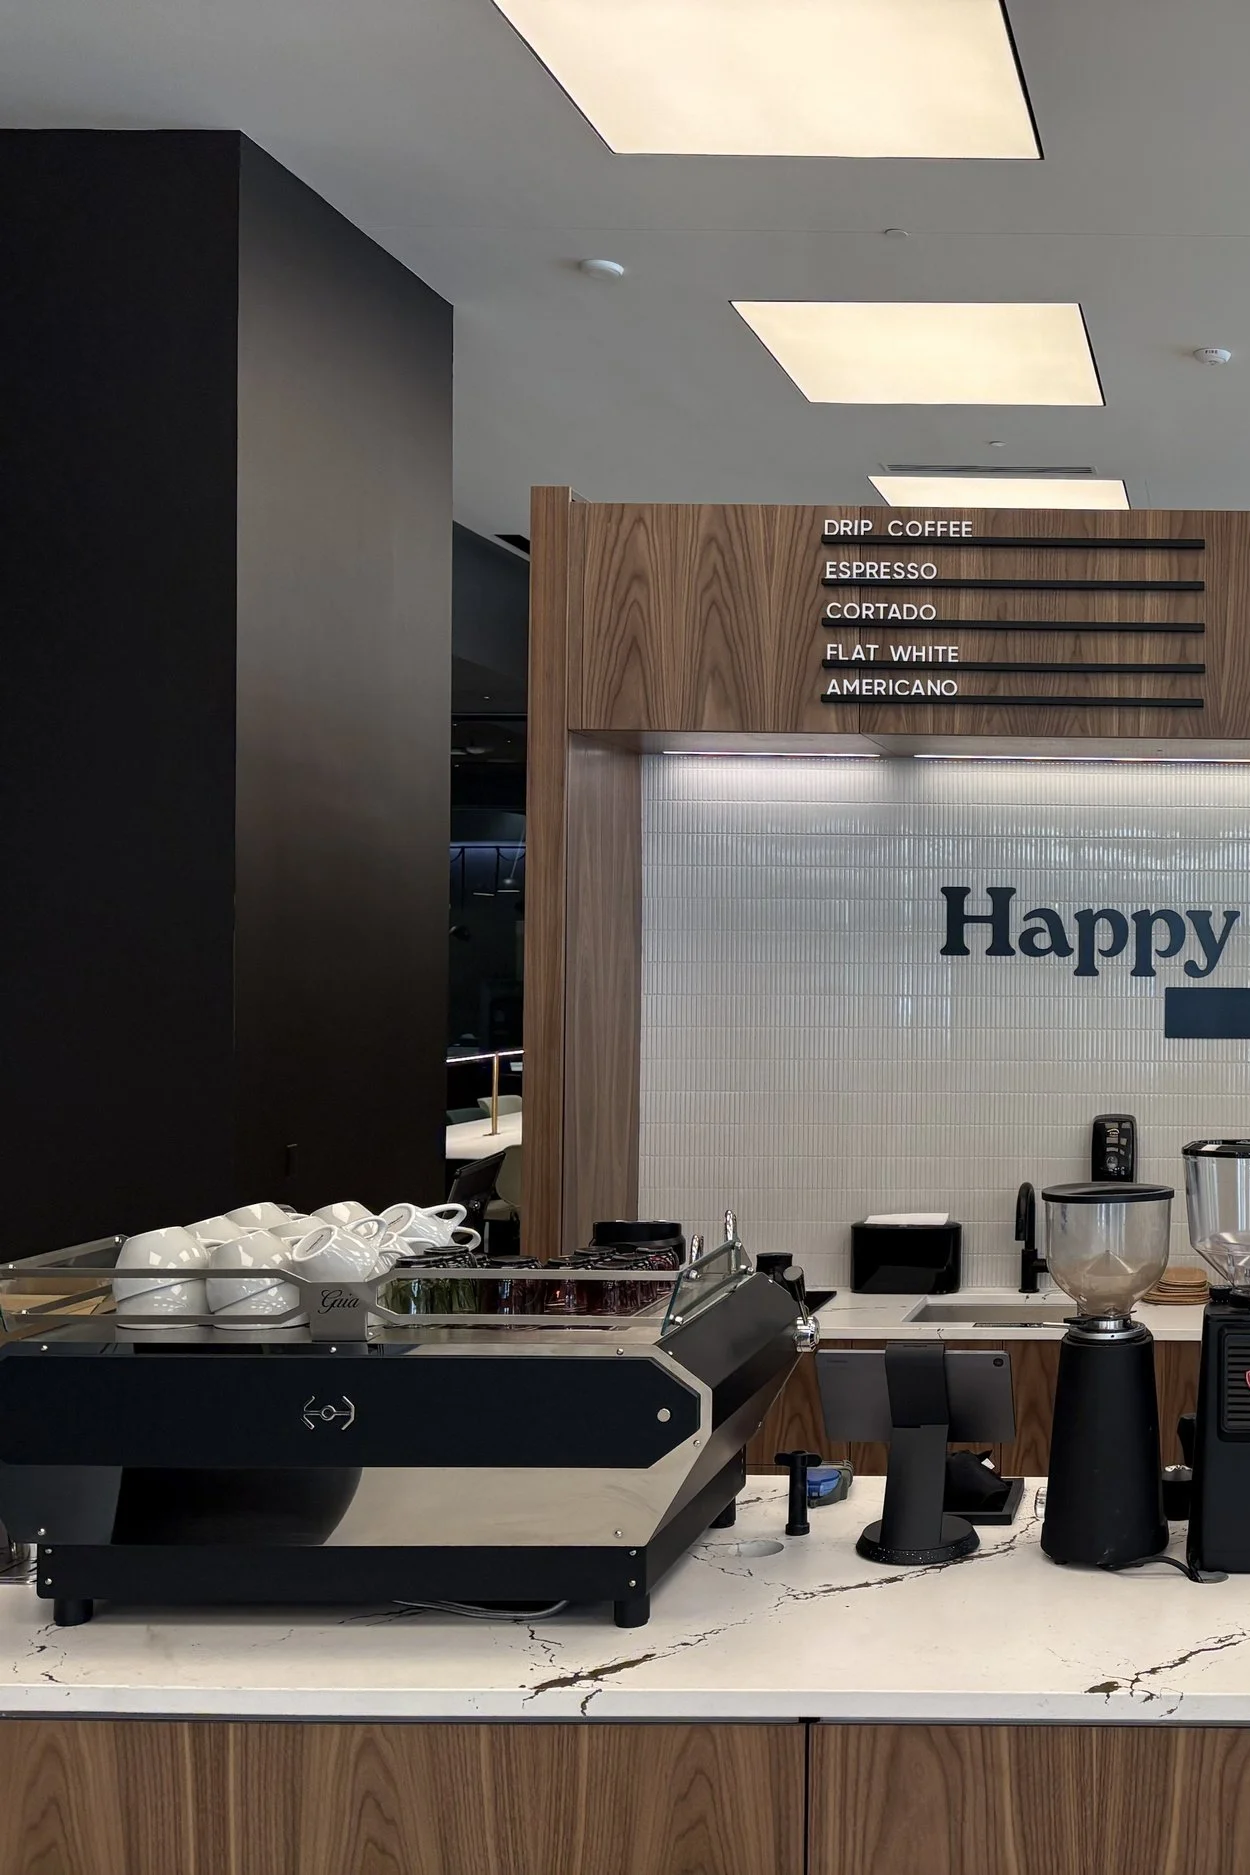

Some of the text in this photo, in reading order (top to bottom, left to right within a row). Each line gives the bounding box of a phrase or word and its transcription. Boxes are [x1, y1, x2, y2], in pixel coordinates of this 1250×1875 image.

[824, 519, 974, 538] DRIP COFFEE
[825, 561, 938, 580] ESPRESSO
[826, 602, 937, 621] CORTADO
[826, 643, 959, 663] FLAT WHITE
[826, 678, 958, 697] AMERICANO
[940, 886, 1240, 978] Happy
[317, 1289, 359, 1315] Gaia
